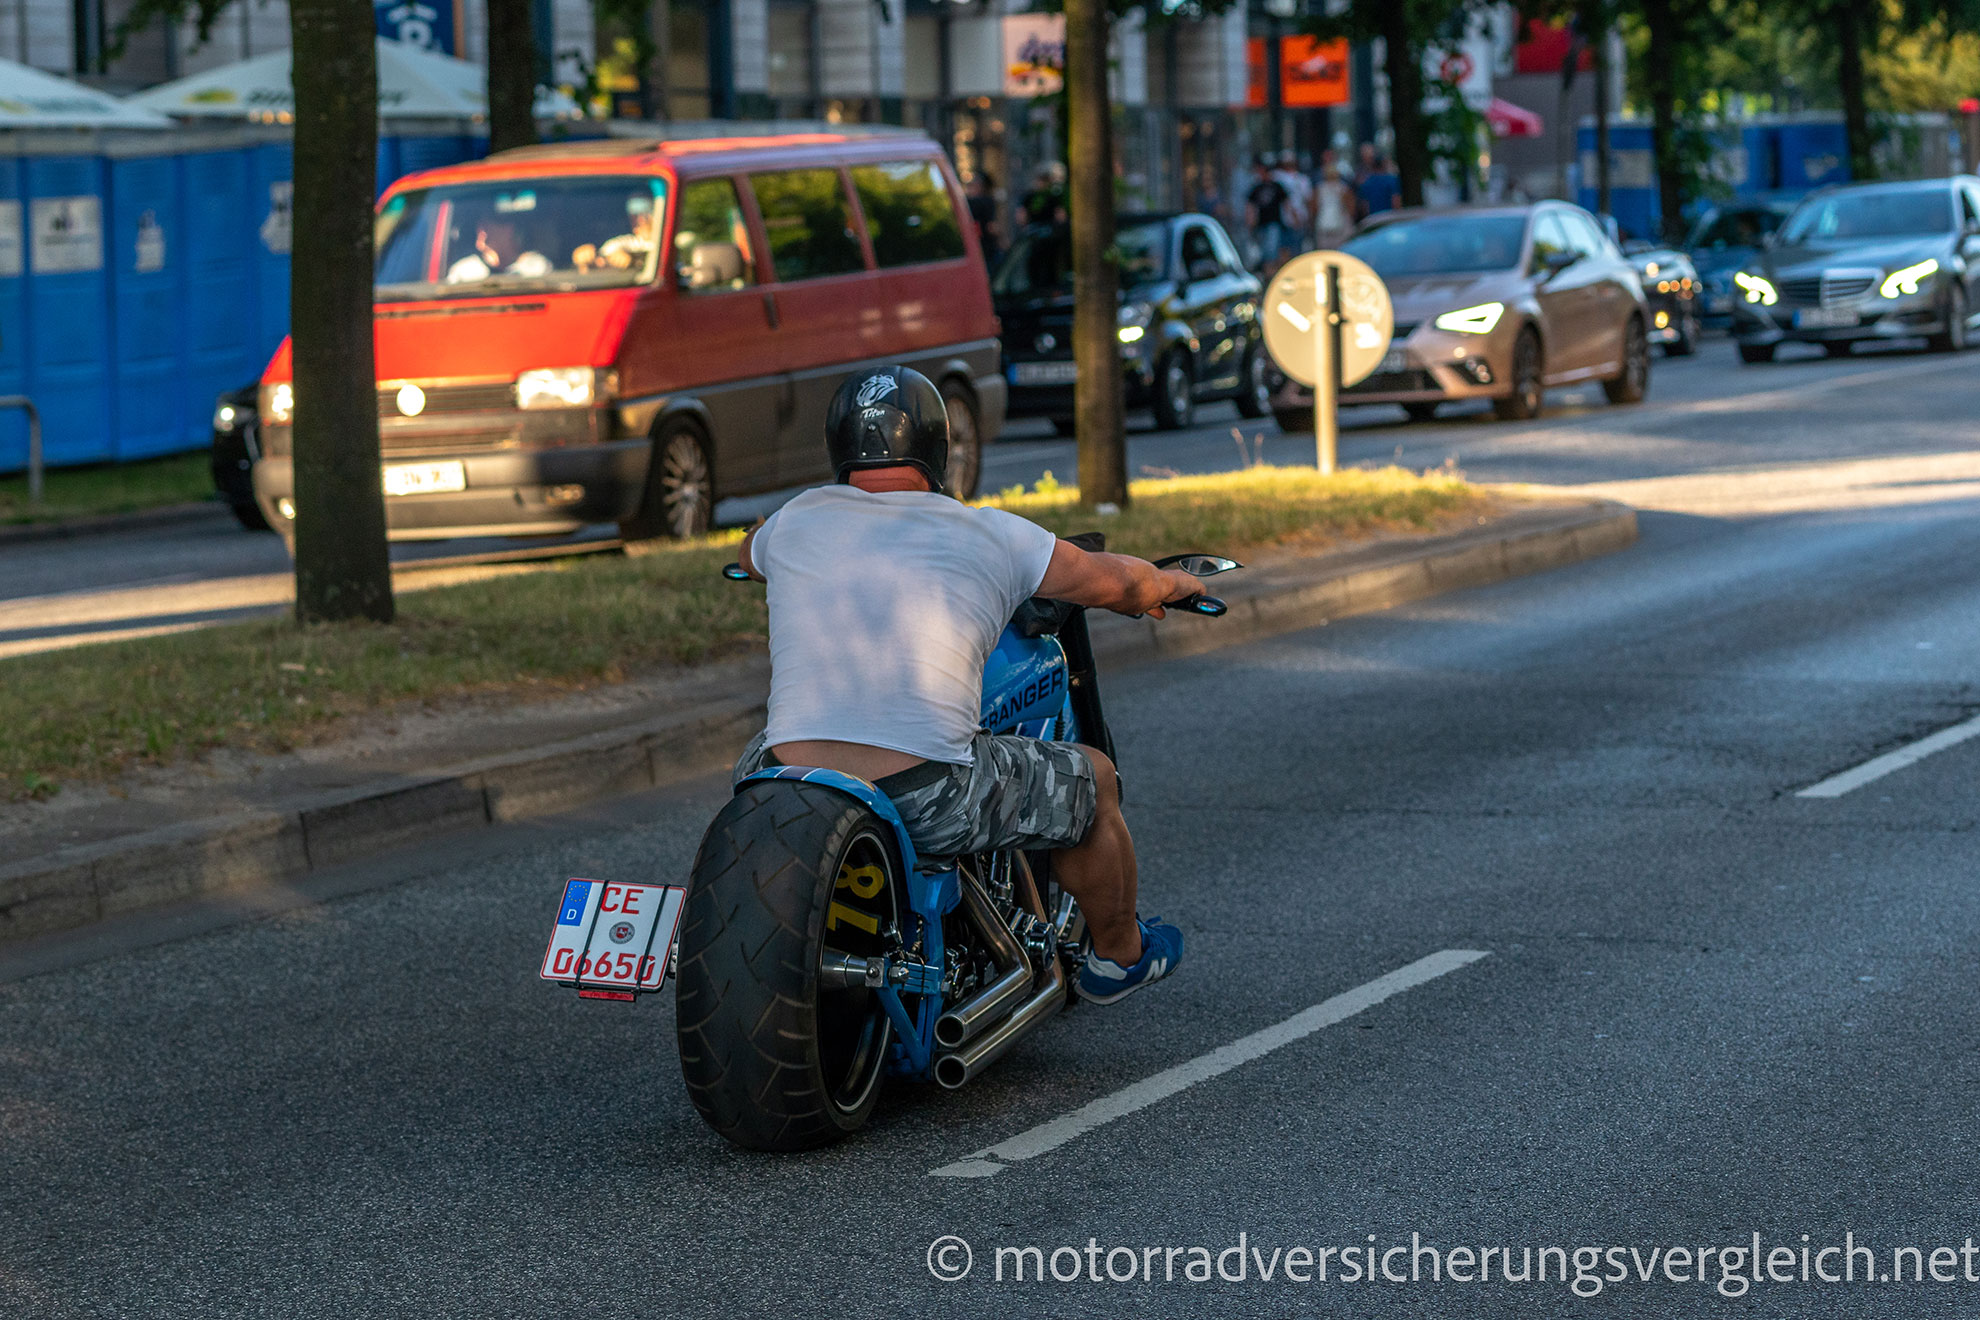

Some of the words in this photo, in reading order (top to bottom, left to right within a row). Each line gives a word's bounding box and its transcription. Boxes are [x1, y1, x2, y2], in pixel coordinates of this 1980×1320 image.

[566, 908, 578, 921] D
[600, 886, 644, 915] CE
[552, 947, 656, 982] 06650
